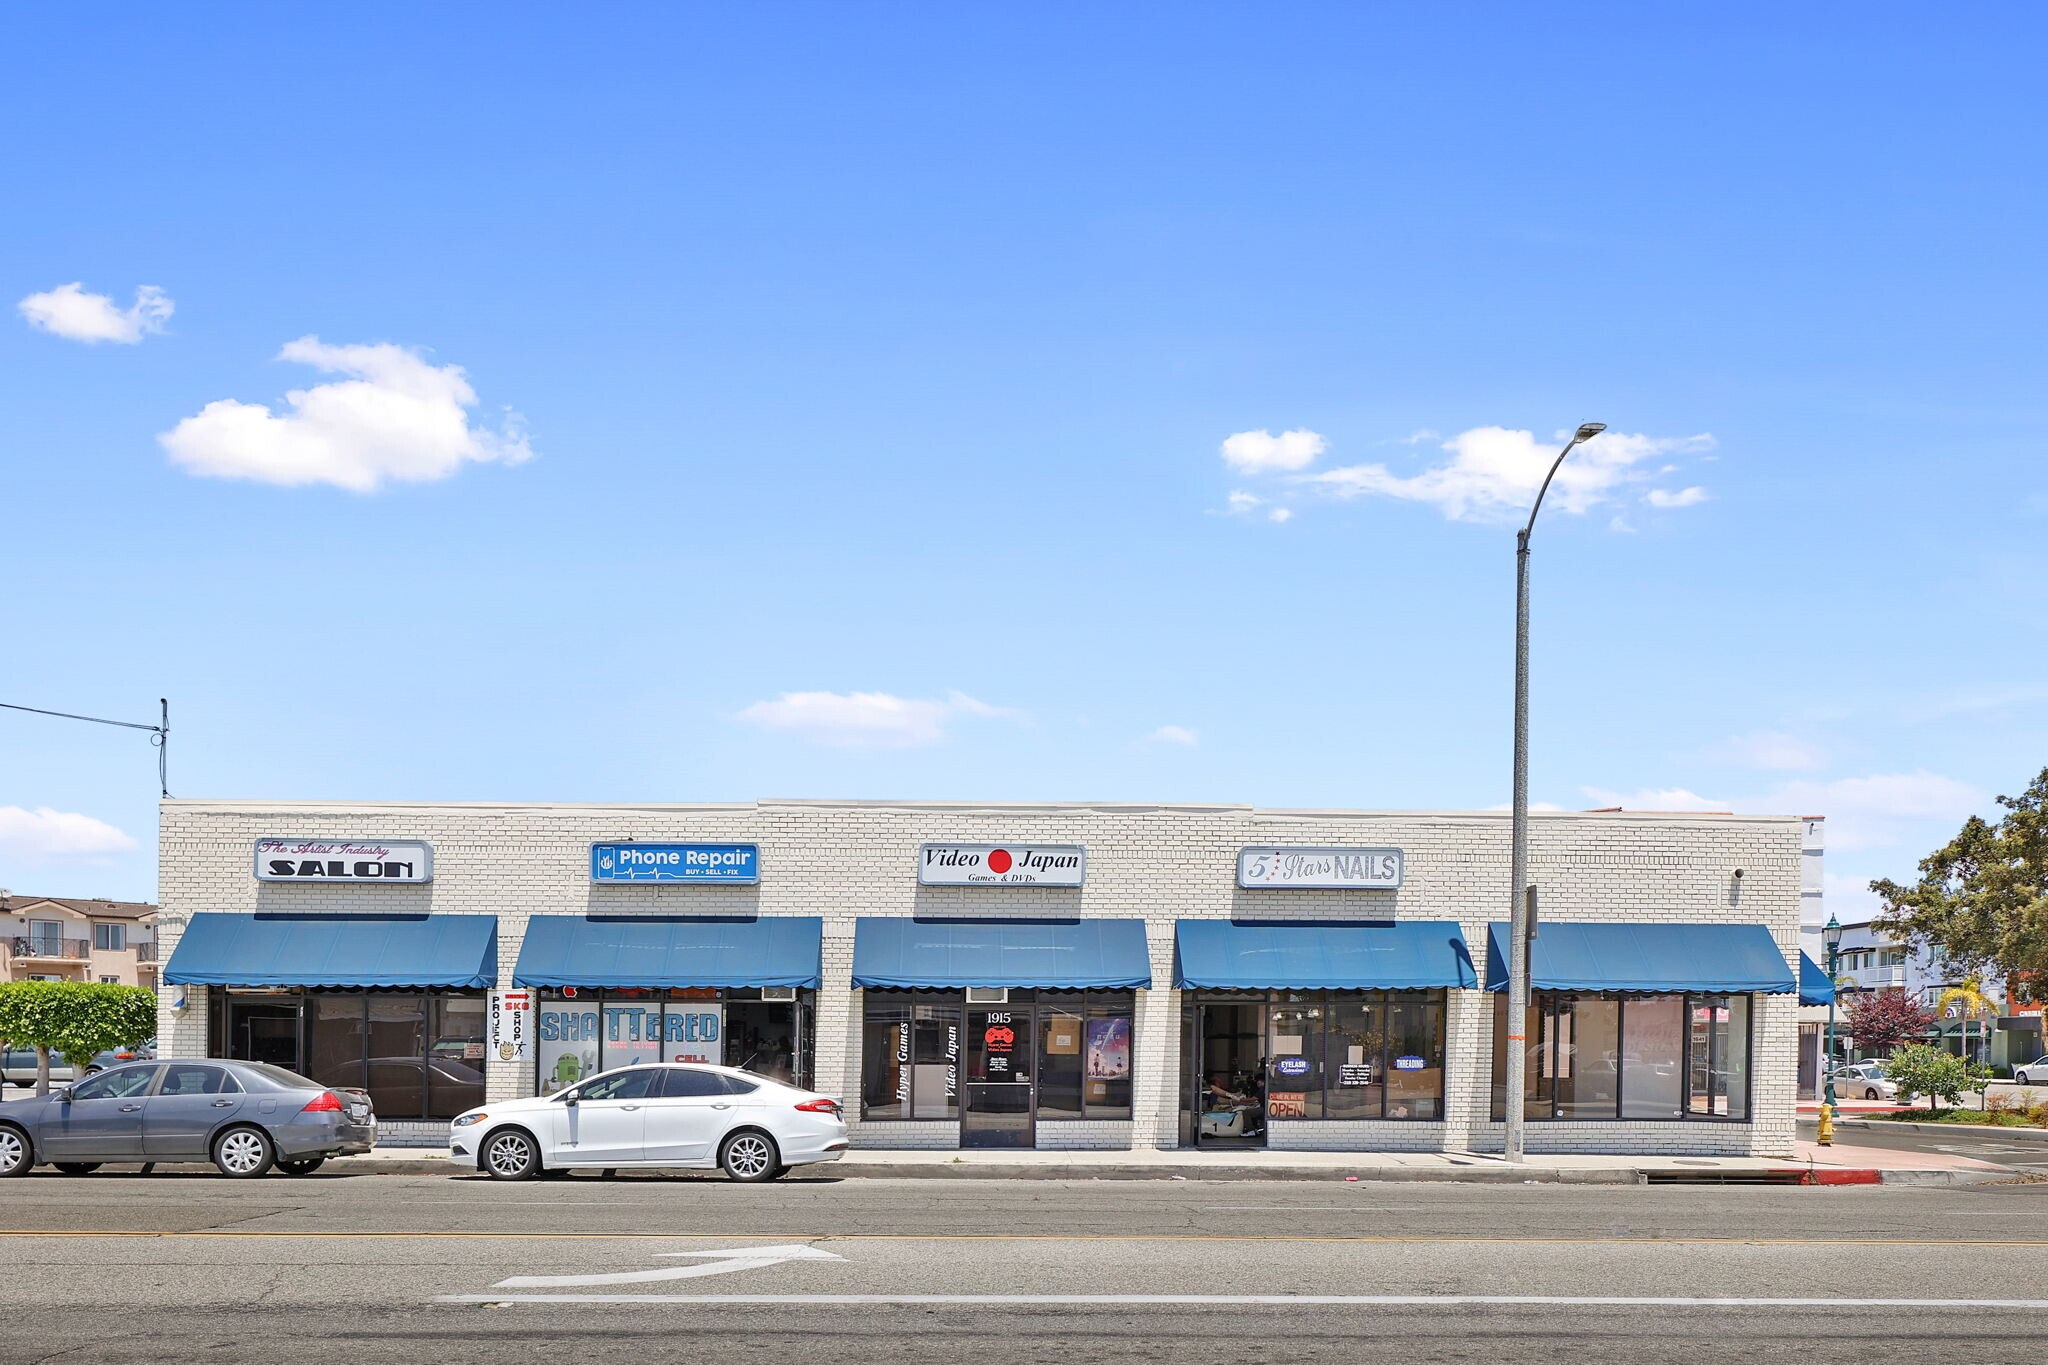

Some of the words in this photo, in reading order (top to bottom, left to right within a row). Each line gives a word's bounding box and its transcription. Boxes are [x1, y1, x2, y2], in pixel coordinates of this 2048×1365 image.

[258, 841, 288, 854] The
[291, 842, 332, 854] Artist
[335, 843, 390, 860] Industry
[620, 850, 680, 865] Phone
[686, 849, 751, 868] Repair
[925, 849, 980, 867] Video
[1019, 850, 1079, 872] Japan
[268, 860, 413, 878] SALON
[968, 873, 996, 882] Games
[1001, 874, 1008, 882] &
[1011, 874, 1036, 882] DVDs
[1248, 856, 1271, 878] 5
[1282, 854, 1331, 880] Stars
[1334, 855, 1396, 880] NAILS
[492, 996, 500, 1049] PROJECT
[513, 1011, 521, 1041] SHOP
[540, 1007, 719, 1042] SHATTERED
[987, 1012, 1012, 1024] 1915
[896, 1022, 909, 1062] Games
[945, 1026, 959, 1062] Japan
[674, 1055, 710, 1063] CELL
[1397, 1059, 1424, 1069] THREADING
[896, 1065, 911, 1101] Hyper
[945, 1064, 957, 1097] Video
[1269, 1102, 1304, 1117] OPEN
